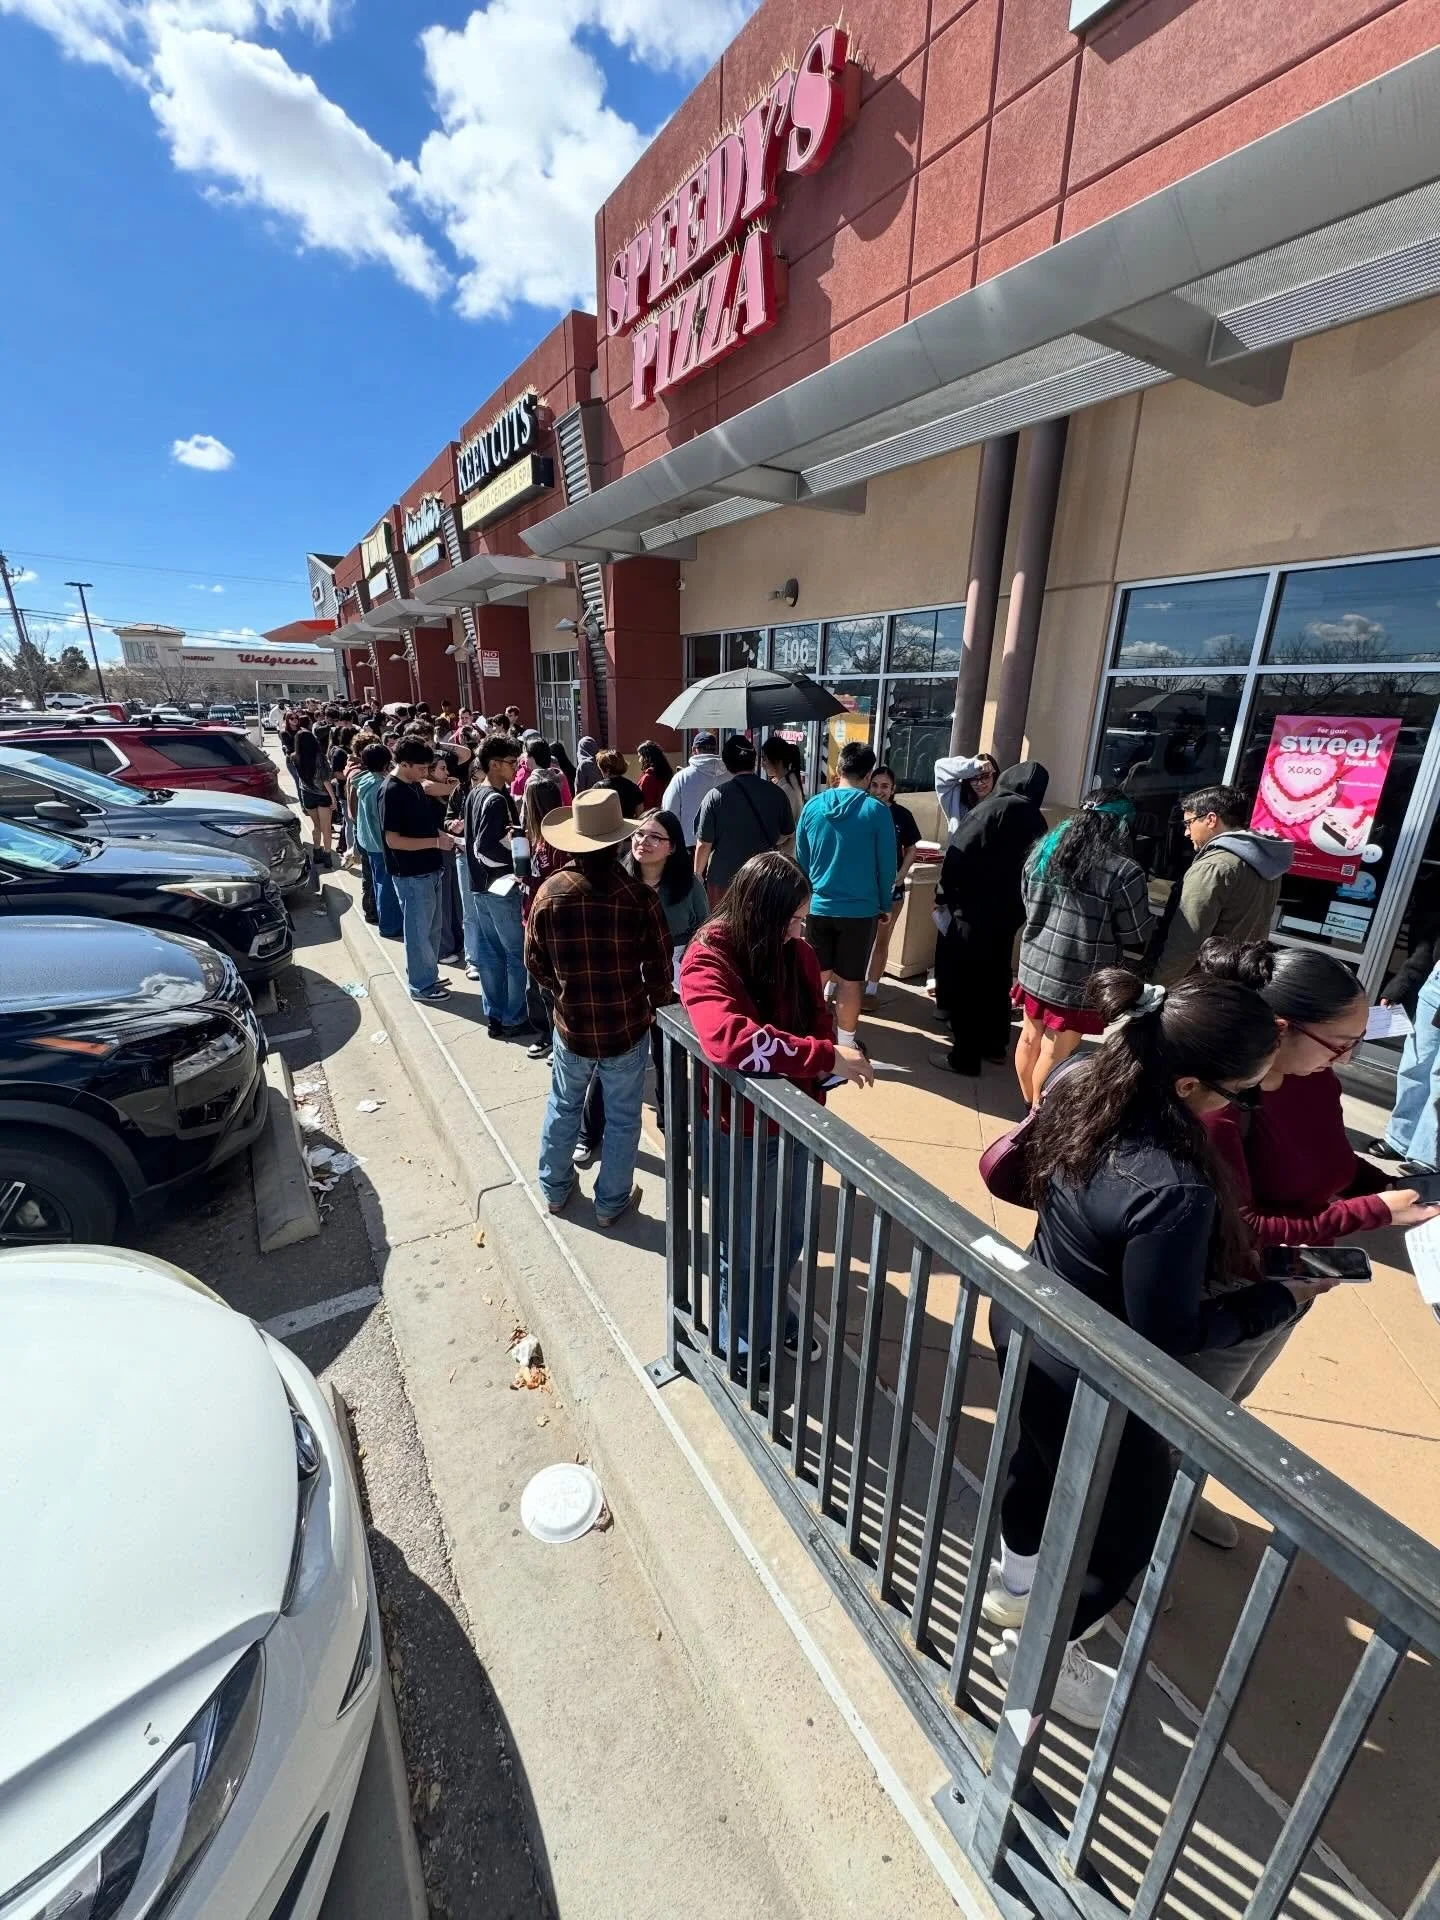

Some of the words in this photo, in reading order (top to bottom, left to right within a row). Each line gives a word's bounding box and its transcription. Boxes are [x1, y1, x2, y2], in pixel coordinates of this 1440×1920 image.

[607, 25, 845, 337] SPEEDY'S
[631, 230, 773, 411] PIZZA
[457, 434, 489, 495] KEEN
[491, 393, 531, 467] CUTS
[478, 490, 491, 514] HAIR
[489, 474, 513, 507] CENTER
[518, 460, 531, 488] SPA
[237, 653, 319, 666] Walgreens
[782, 639, 809, 665] 106
[1317, 726, 1328, 734] for
[1280, 733, 1383, 758] sweet
[1344, 757, 1377, 767] heart
